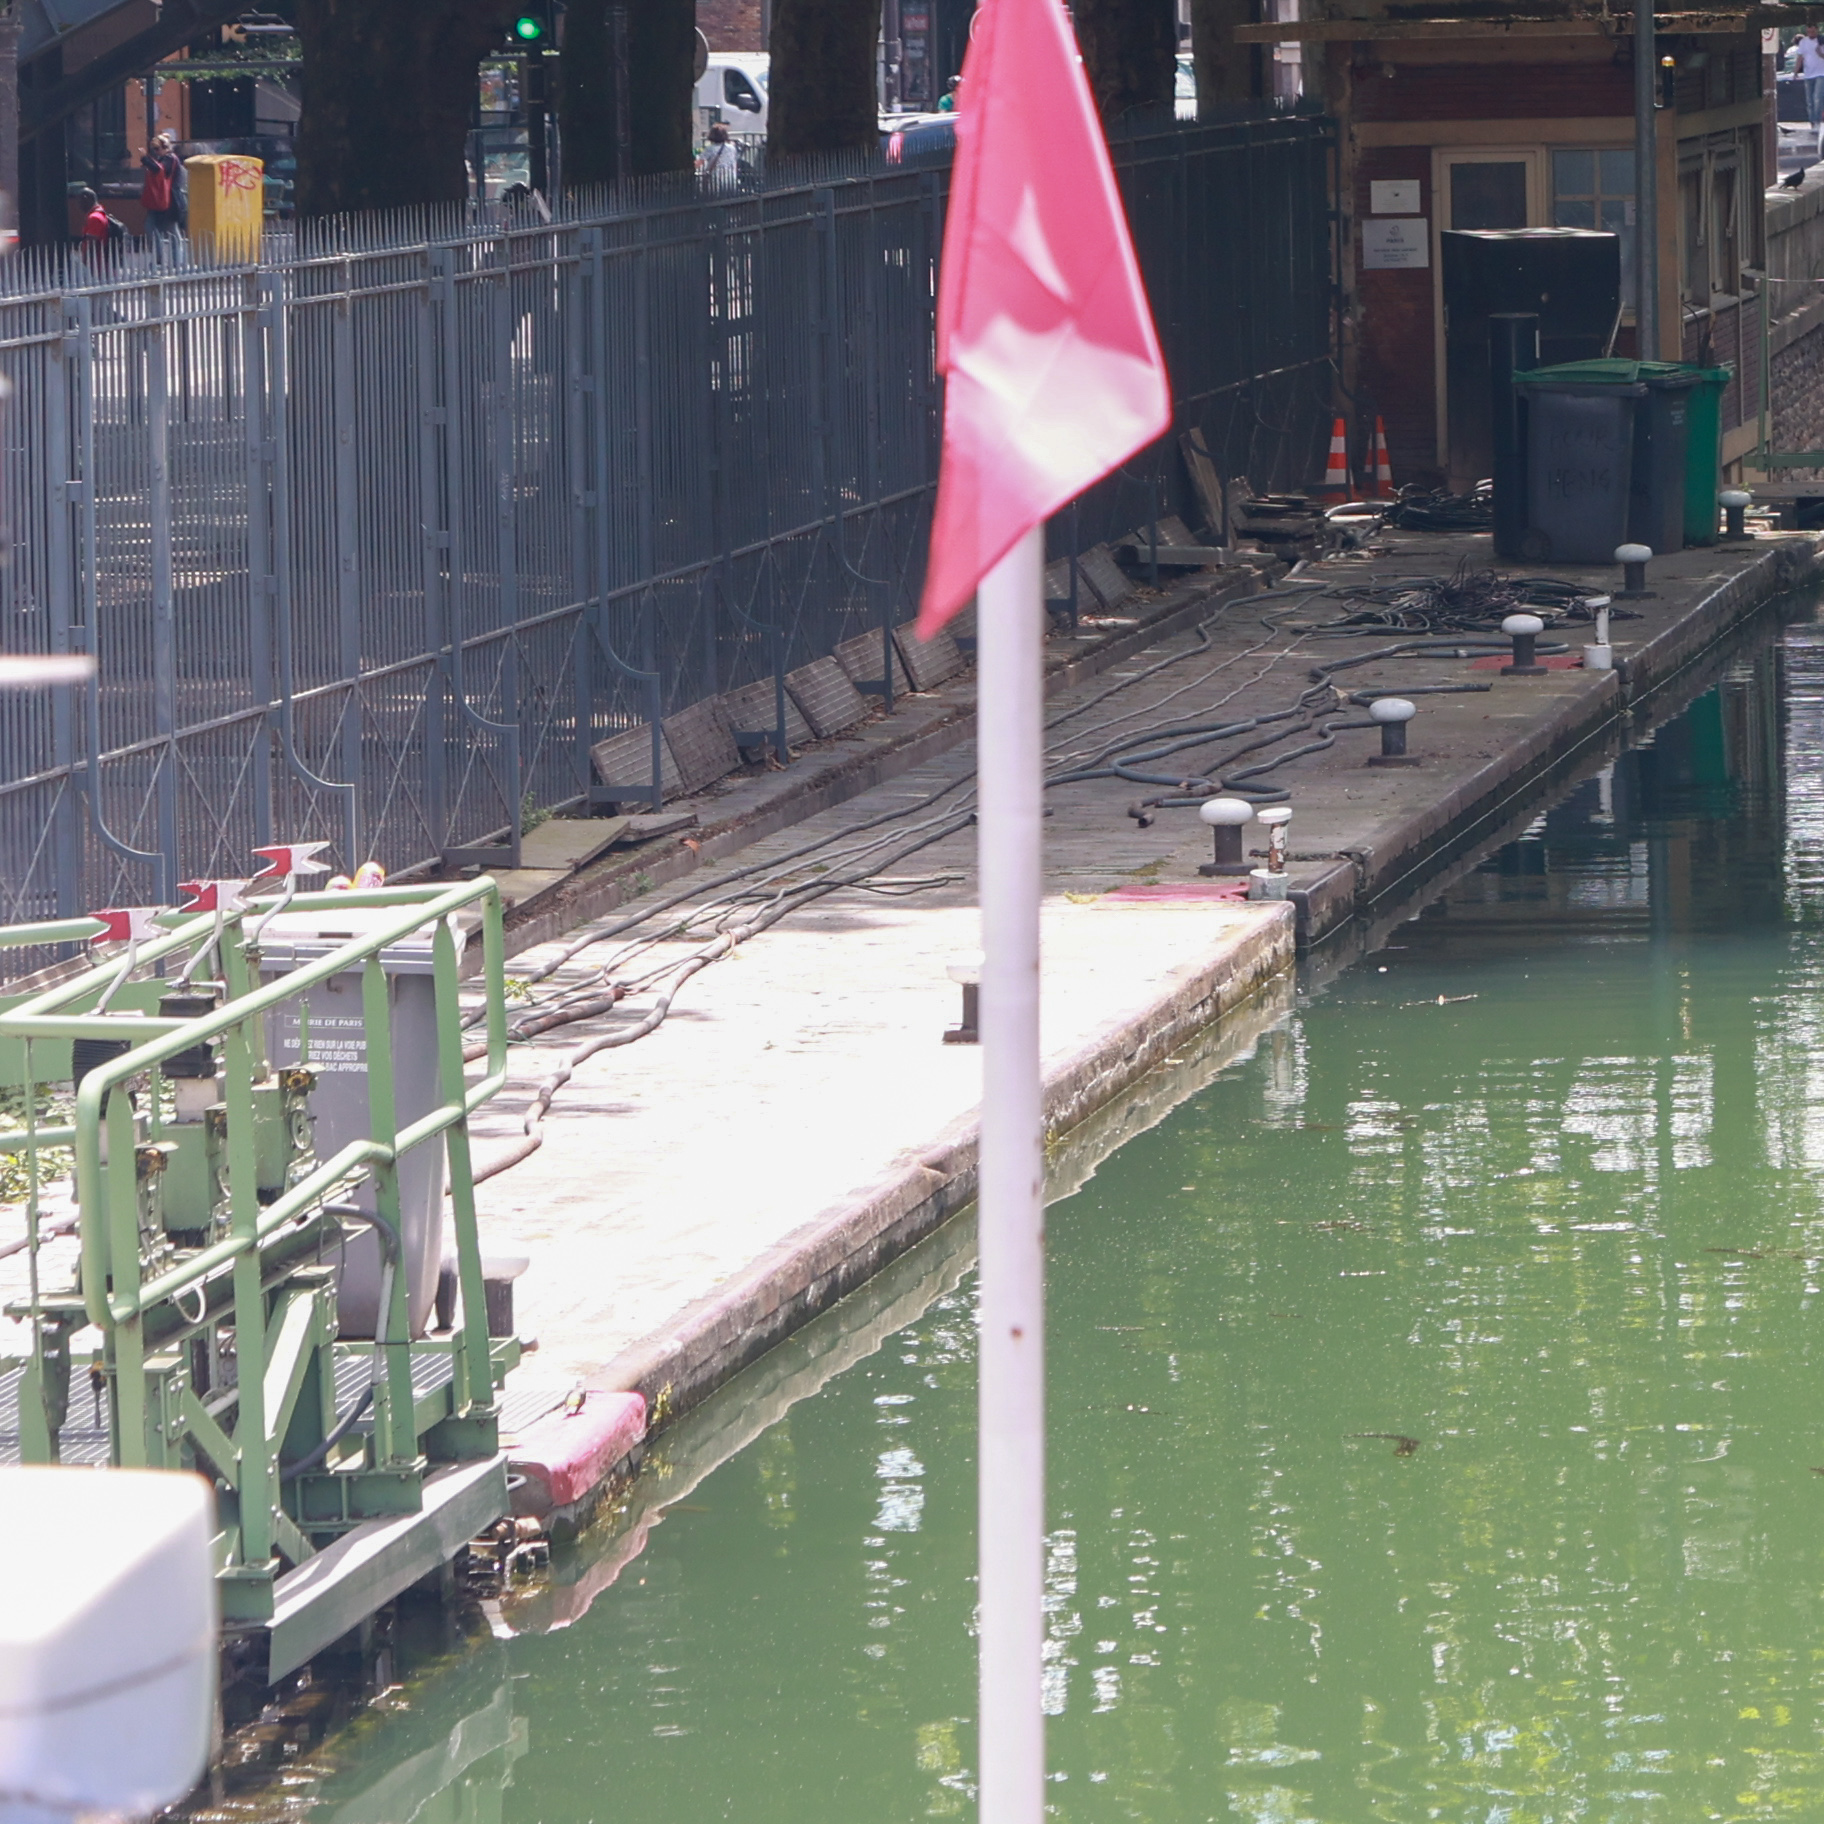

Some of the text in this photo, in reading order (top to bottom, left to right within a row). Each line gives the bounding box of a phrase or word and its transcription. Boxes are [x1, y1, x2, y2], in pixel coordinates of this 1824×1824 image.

[292, 1018, 322, 1026] MIRIE
[284, 1038, 291, 1048] NE
[313, 1039, 325, 1049] RIEN
[325, 1039, 336, 1049] SUR
[336, 1040, 343, 1049] LA
[344, 1040, 356, 1050] VOIE
[307, 1050, 321, 1060] RIEZ
[321, 1051, 332, 1060] VOS
